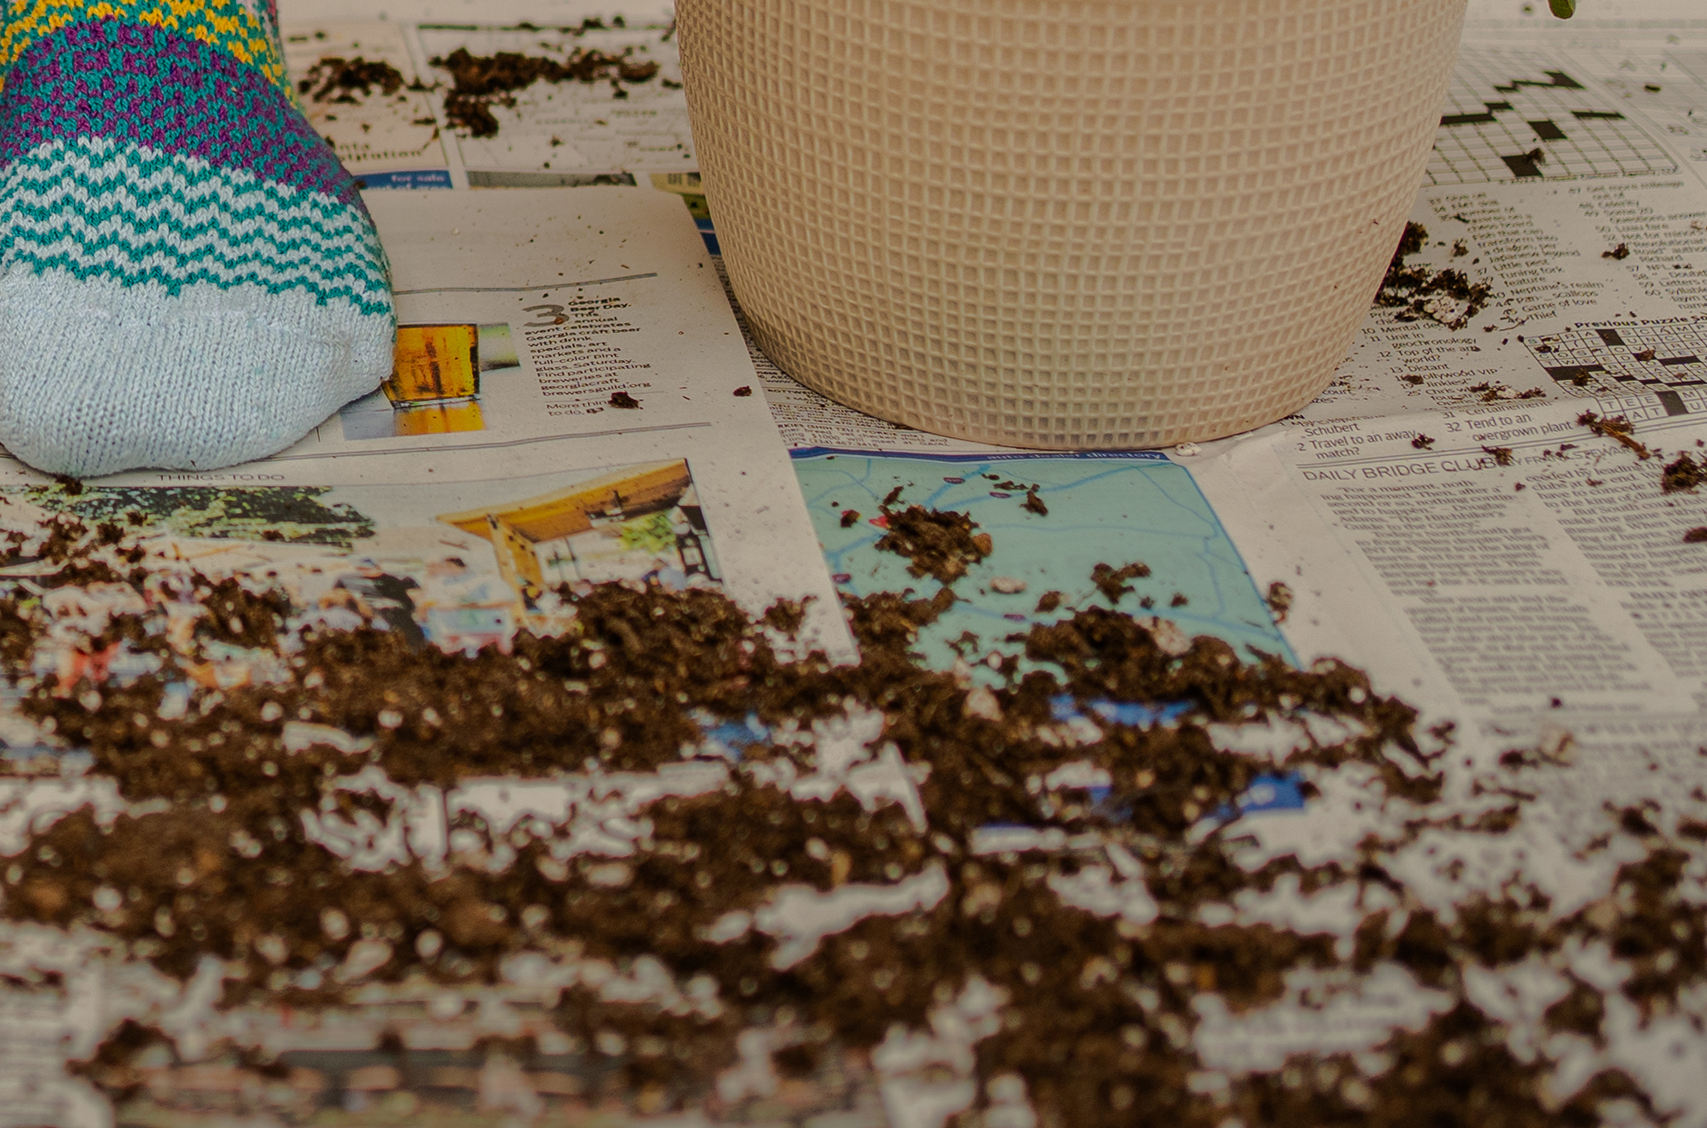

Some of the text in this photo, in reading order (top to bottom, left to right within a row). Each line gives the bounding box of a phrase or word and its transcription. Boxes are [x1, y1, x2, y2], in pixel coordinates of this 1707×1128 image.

[1509, 282, 1565, 296] Neptune's
[568, 297, 621, 306] Georgia
[603, 302, 632, 310] Day.
[1522, 303, 1557, 313] Game
[1573, 298, 1598, 306] love
[522, 304, 570, 327] 3
[574, 316, 617, 324] annual
[524, 322, 632, 336] event celebrates
[1380, 324, 1422, 334] Mental
[1575, 316, 1688, 329] Previous Puzzle
[526, 332, 577, 342] Georgia
[578, 328, 609, 336] craft
[528, 336, 593, 347] with drink
[1385, 332, 1410, 341] Unit
[532, 349, 584, 359] markets
[1397, 345, 1456, 358] Top of the
[533, 352, 620, 365] full-color pint
[1402, 354, 1441, 365] world?
[567, 363, 652, 377] participating
[1389, 362, 1450, 374] 13 Distant
[1480, 366, 1498, 375] VIP
[539, 374, 602, 384] breweries
[541, 377, 620, 391] georgiacraft
[542, 381, 652, 397] brewersguild.org
[546, 402, 580, 410] More
[565, 408, 584, 416] do,
[1442, 411, 1457, 419] 31
[1445, 413, 1532, 433] 32 Tend to an
[1304, 423, 1361, 438] Schubert
[1472, 421, 1575, 442] overgrown plant
[1297, 430, 1417, 452] 2 Travel to an away
[1087, 452, 1160, 460] directory
[1315, 446, 1360, 460] match?
[1302, 455, 1498, 482] DAILY BRIDGE CLUB
[1574, 464, 1643, 478] by leading
[156, 473, 285, 481] THINGS TO DO
[1531, 473, 1637, 491] clubs end.
[1537, 484, 1646, 500] have to concede
[1560, 499, 1583, 507] the
[1584, 496, 1616, 506] king
[1617, 493, 1633, 502] of
[1452, 502, 1507, 512] Douglas
[1425, 511, 1506, 521] Hitchhiker's
